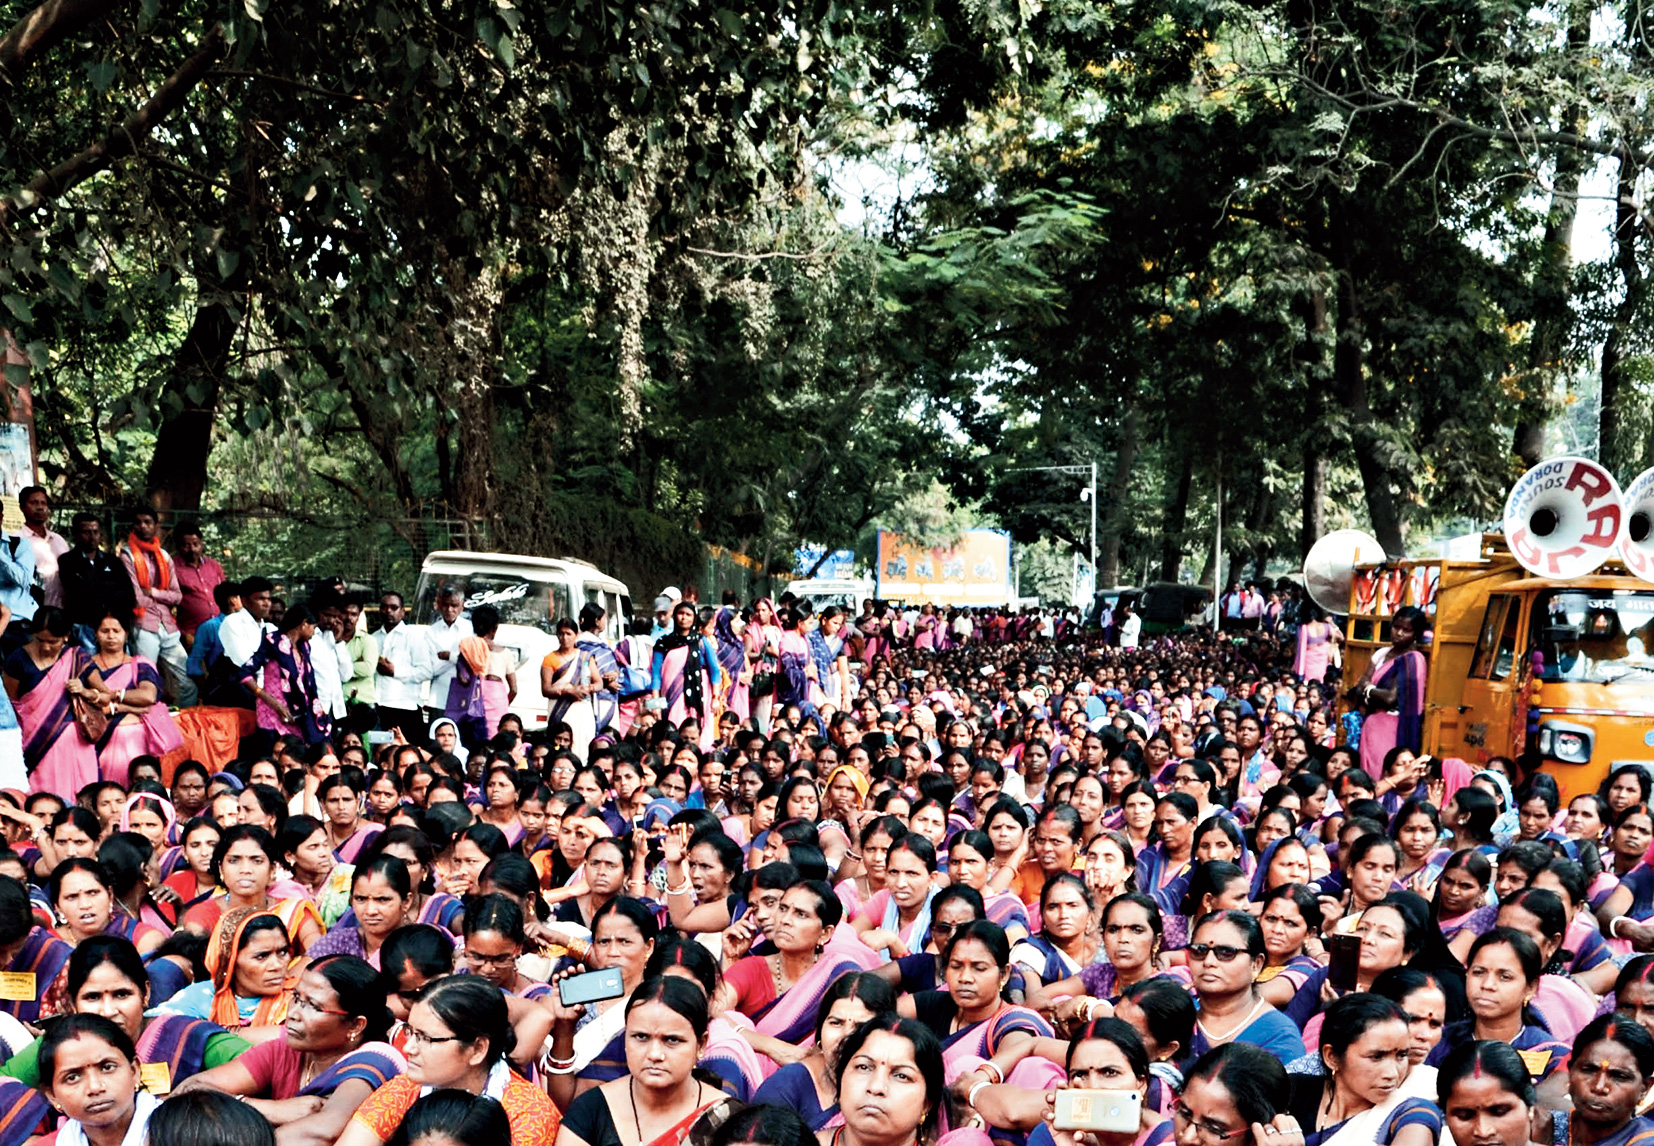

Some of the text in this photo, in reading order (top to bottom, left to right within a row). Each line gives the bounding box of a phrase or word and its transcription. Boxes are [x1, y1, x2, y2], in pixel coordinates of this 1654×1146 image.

[1509, 462, 1564, 519] DORANDA
[1519, 476, 1566, 520] SOUND
[1587, 598, 1617, 610] जय
